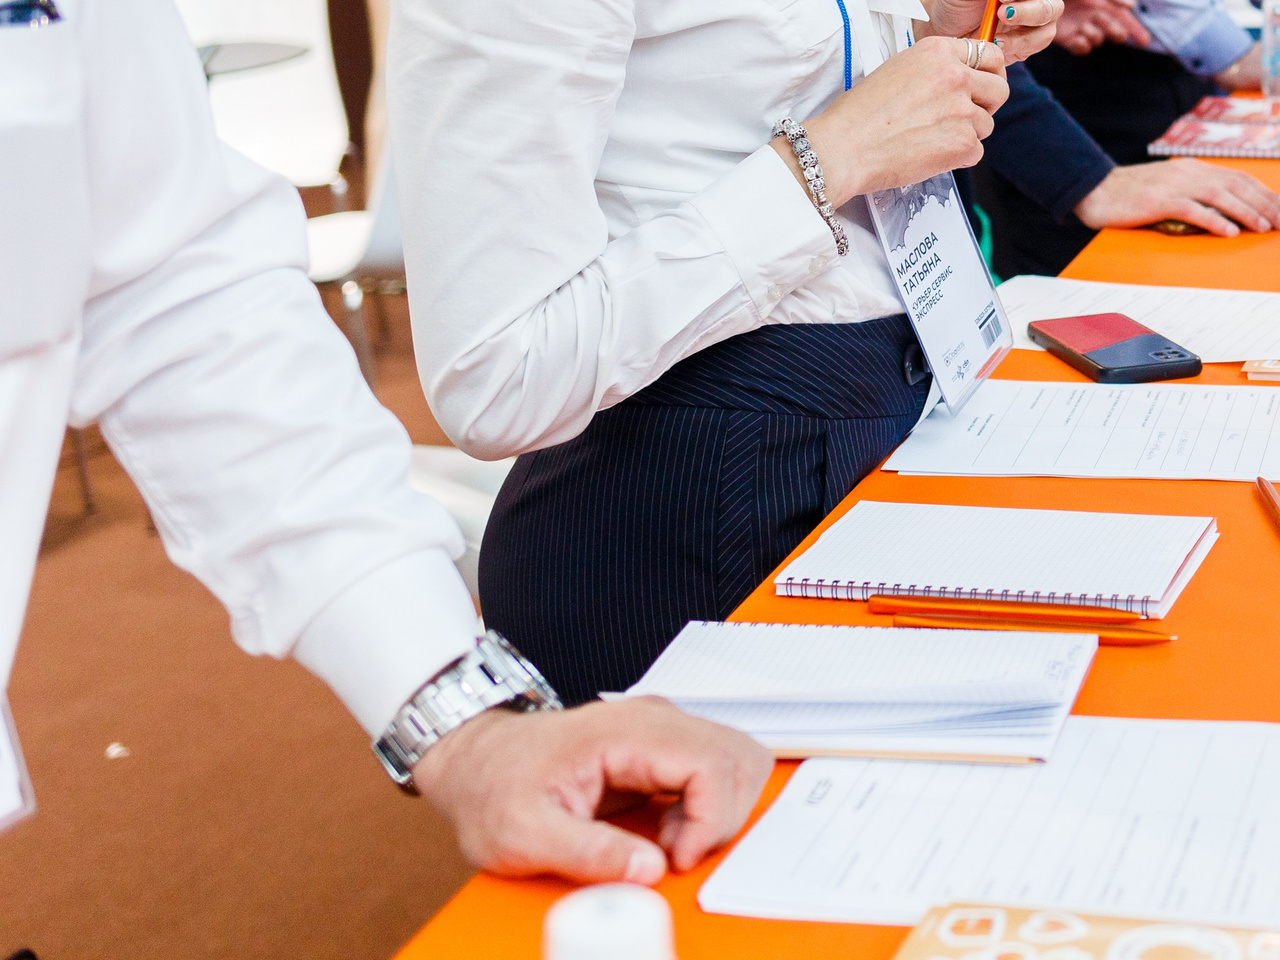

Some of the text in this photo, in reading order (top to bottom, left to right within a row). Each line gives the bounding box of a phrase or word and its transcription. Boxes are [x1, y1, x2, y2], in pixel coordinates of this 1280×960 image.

[896, 231, 939, 279] МАСЛОВА
[902, 253, 942, 296] ТАТЬЯНА
[931, 265, 954, 291] СЕРВИС
[915, 290, 944, 323] ЭКСПРЕСС
